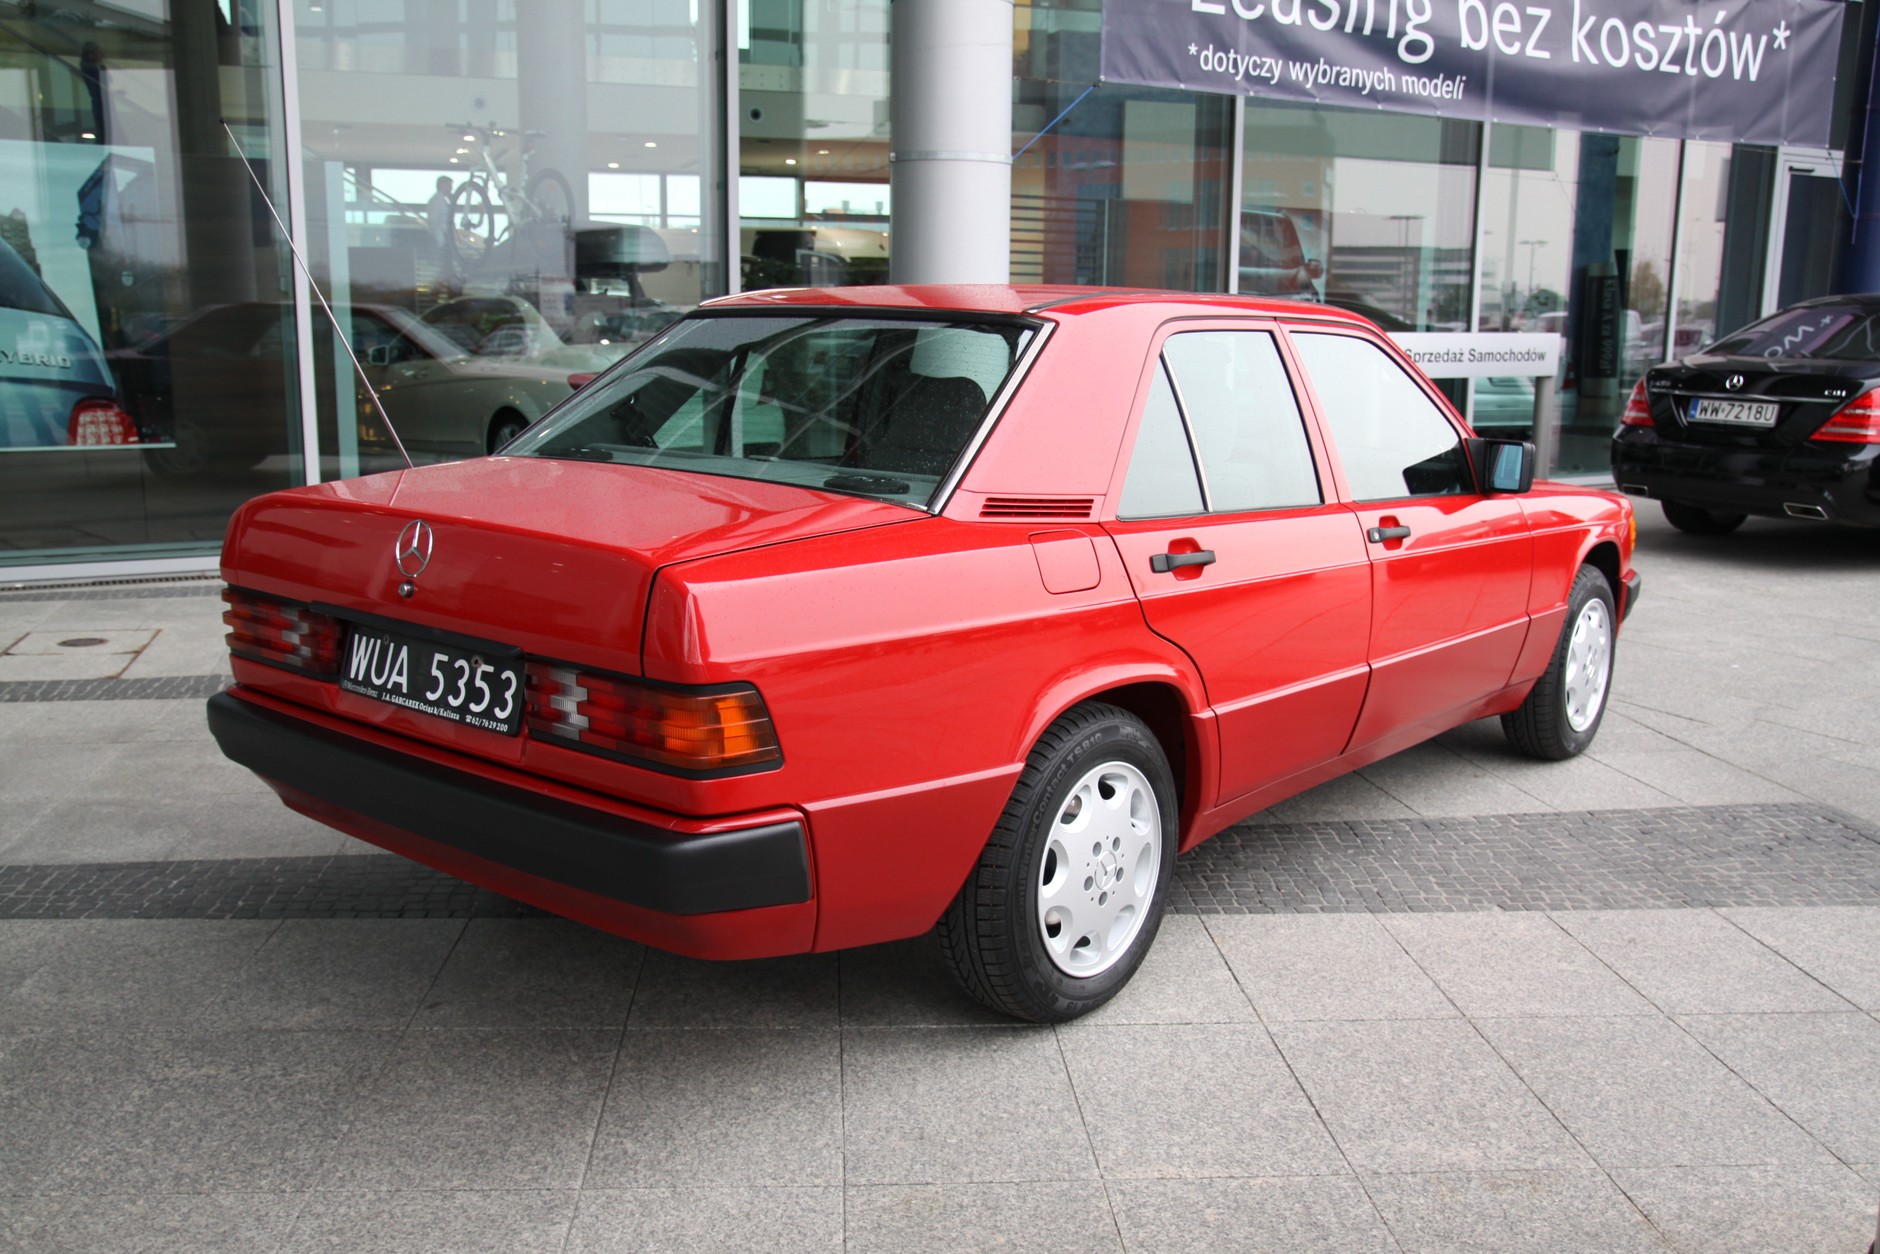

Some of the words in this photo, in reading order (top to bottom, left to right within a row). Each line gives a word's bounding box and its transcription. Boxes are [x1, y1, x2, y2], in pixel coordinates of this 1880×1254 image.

[1458, 0, 1552, 59] bez
[1289, 57, 1396, 95] wybranych
[1401, 73, 1467, 101] modeli
[0, 349, 71, 369] YBRID
[1404, 348, 1464, 364] Sprzedaż
[1468, 348, 1547, 363] Samochodów
[1698, 401, 1721, 418] WW
[1724, 403, 1776, 422] 7218U
[349, 633, 409, 694] WUA
[425, 652, 518, 720] 5353
